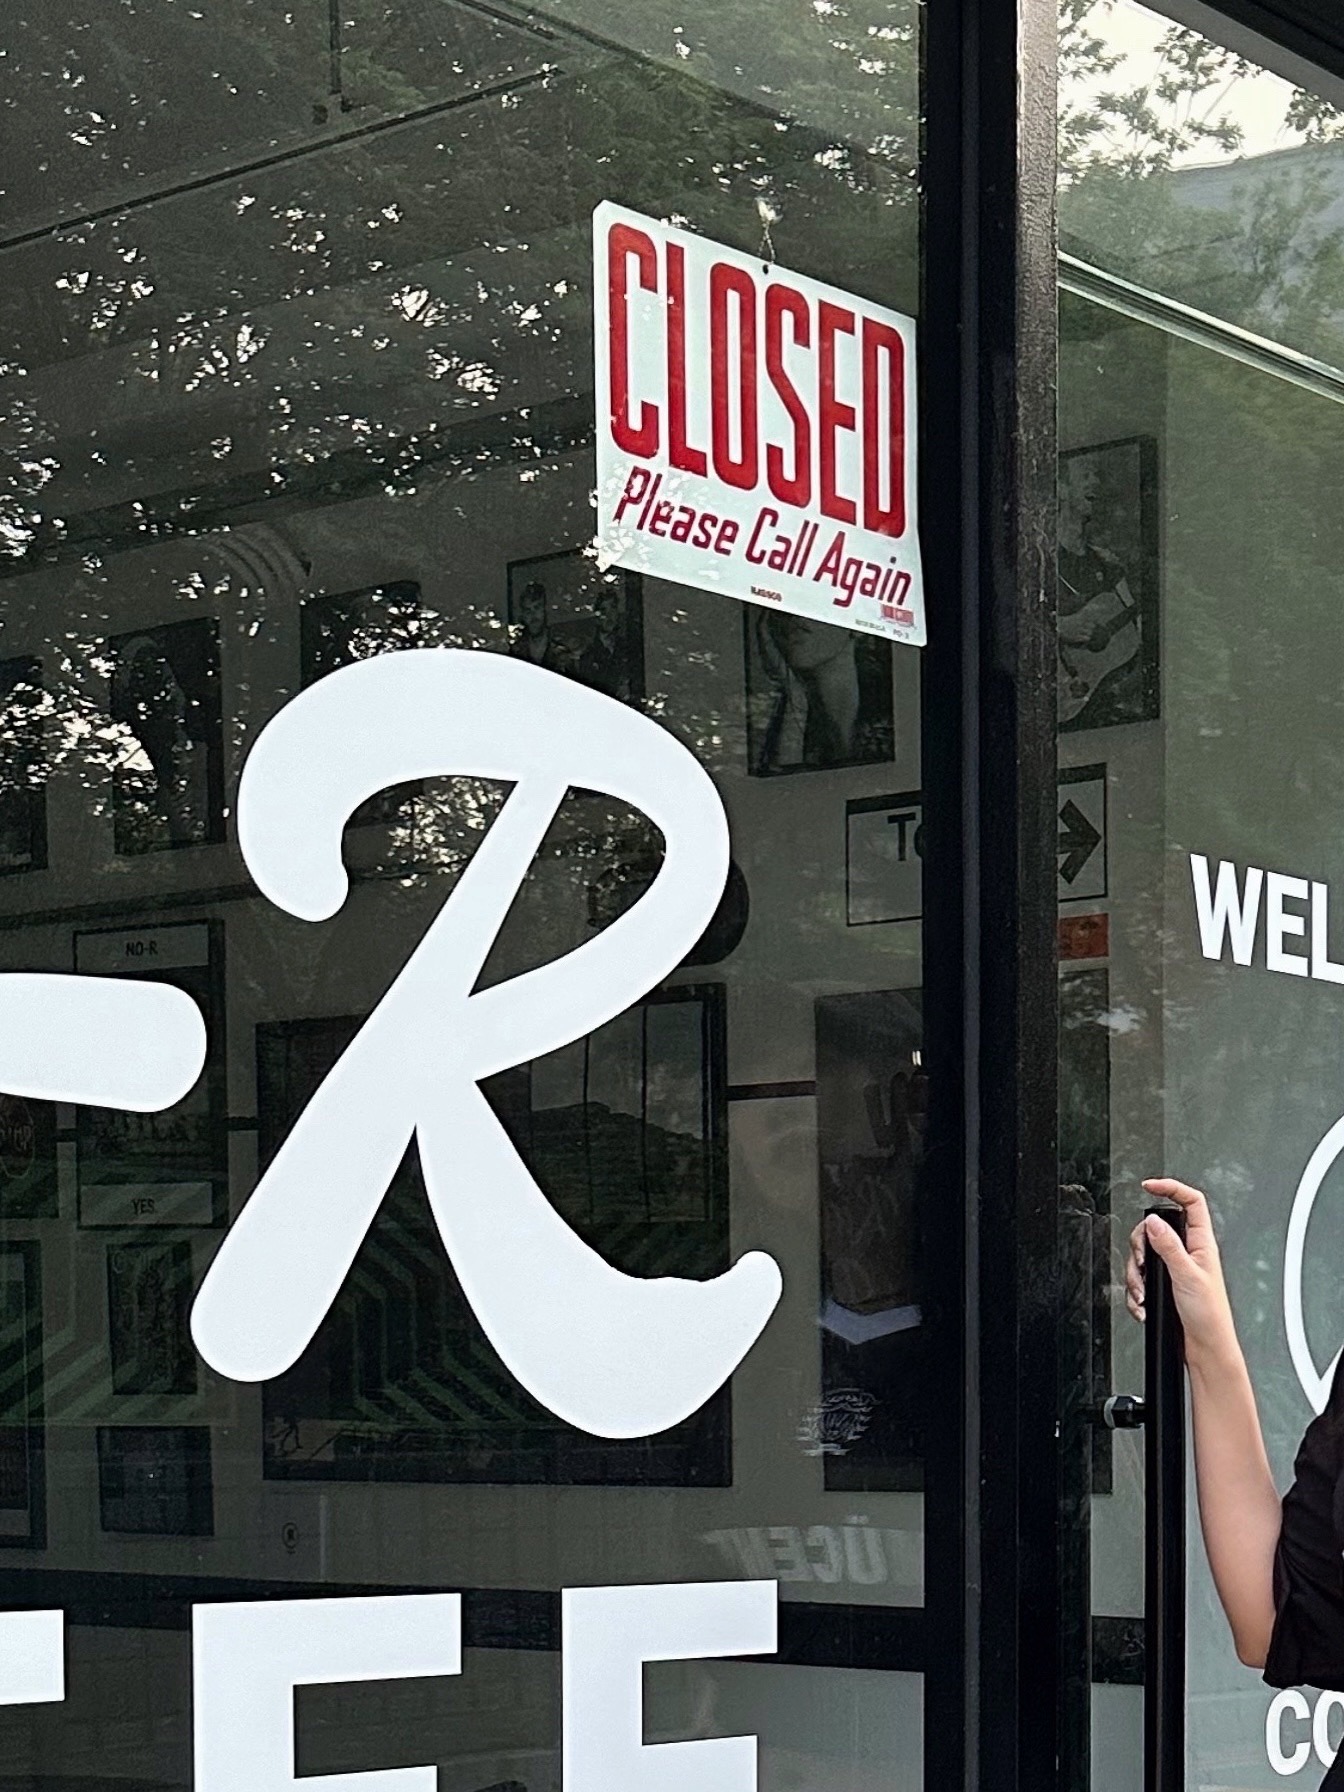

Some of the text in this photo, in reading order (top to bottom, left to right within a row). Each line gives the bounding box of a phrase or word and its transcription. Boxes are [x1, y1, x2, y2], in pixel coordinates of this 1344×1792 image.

[608, 222, 905, 539] CLOSED
[613, 466, 911, 608] Please Call Again
[887, 811, 922, 861] T
[131, 1198, 155, 1214] YES
